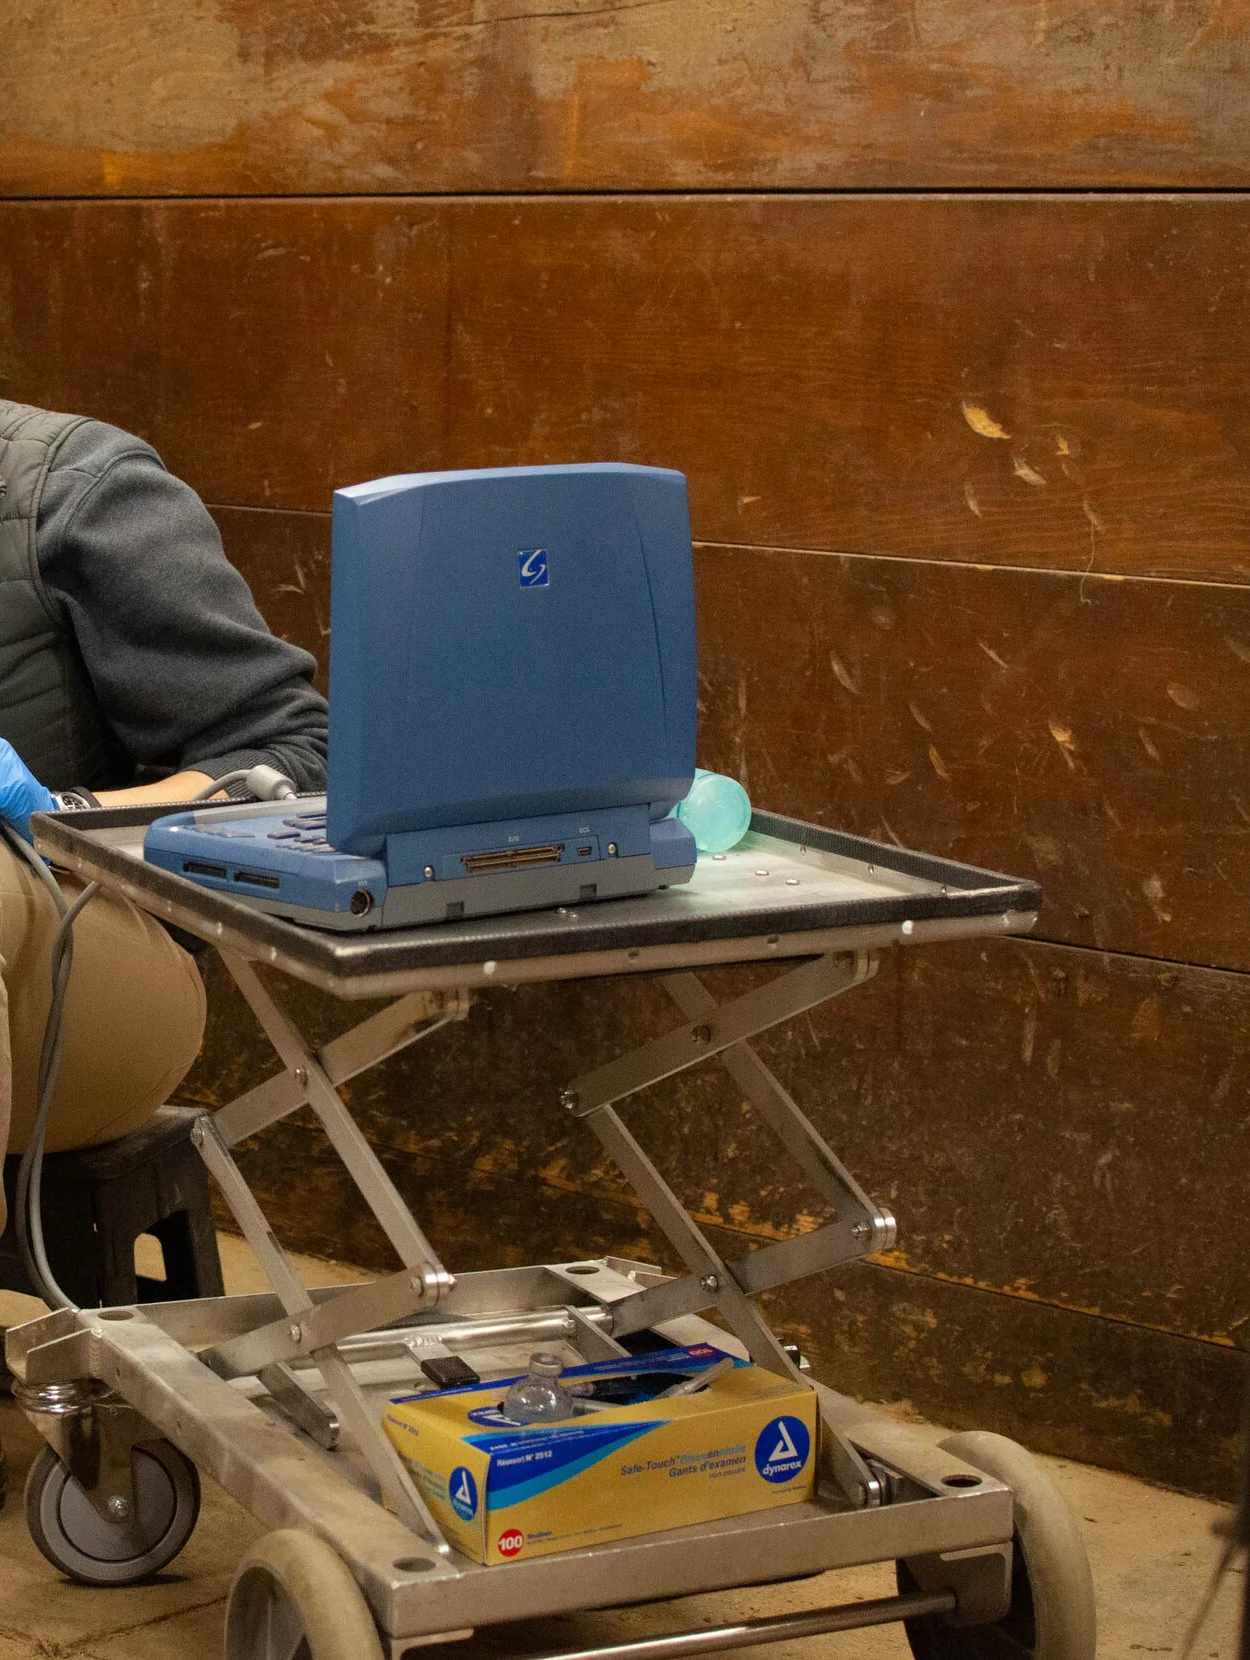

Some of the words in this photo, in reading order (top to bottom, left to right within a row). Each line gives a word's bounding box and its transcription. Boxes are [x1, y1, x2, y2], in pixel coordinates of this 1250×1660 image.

[669, 1465, 698, 1477] Gants
[700, 1456, 746, 1472] d'examen
[762, 1460, 802, 1477] dynarex
[499, 1535, 524, 1551] 100
